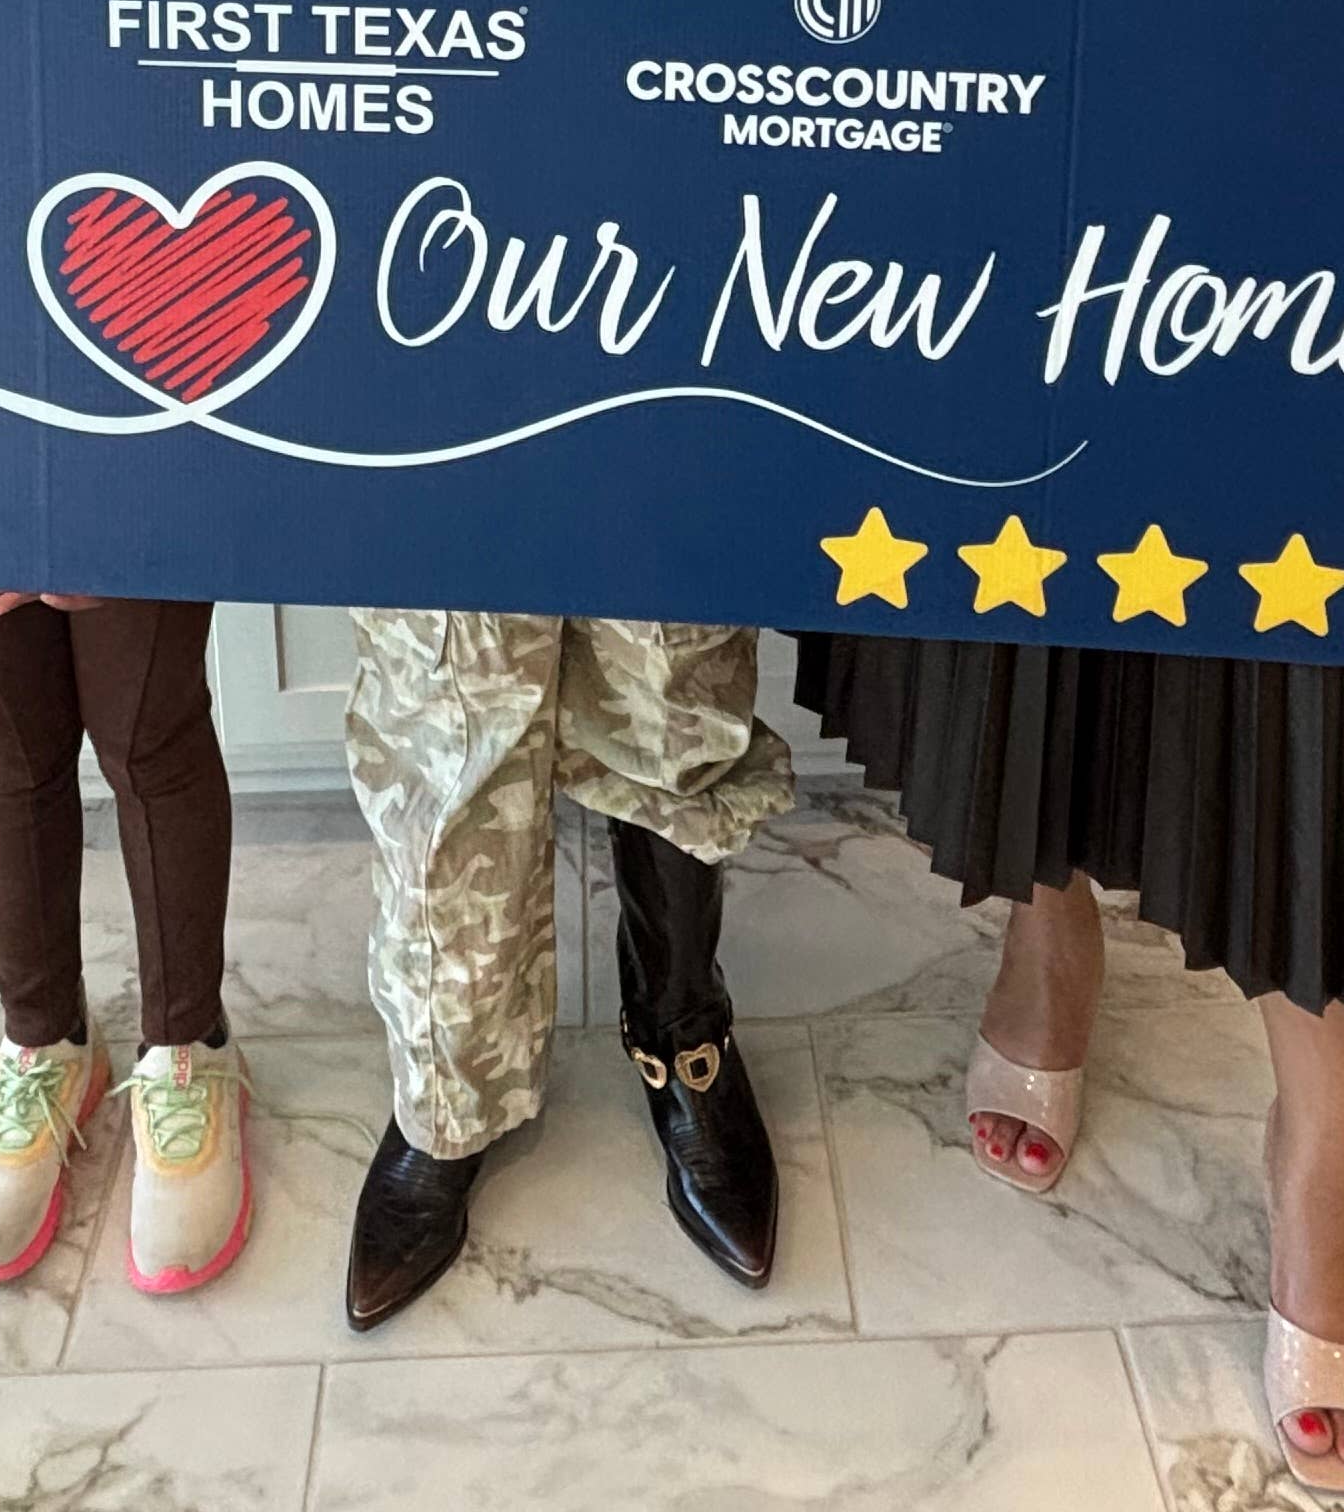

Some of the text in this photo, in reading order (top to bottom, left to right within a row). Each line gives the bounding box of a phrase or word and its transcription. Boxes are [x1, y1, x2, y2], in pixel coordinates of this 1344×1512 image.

[108, 0, 526, 61] FIRST TEXAS
[202, 79, 434, 135] HOMES
[626, 60, 1046, 114] CROSSCOUNTRY
[723, 113, 942, 153] MORTGAGE
[376, 176, 675, 355] Our
[700, 192, 996, 367] New
